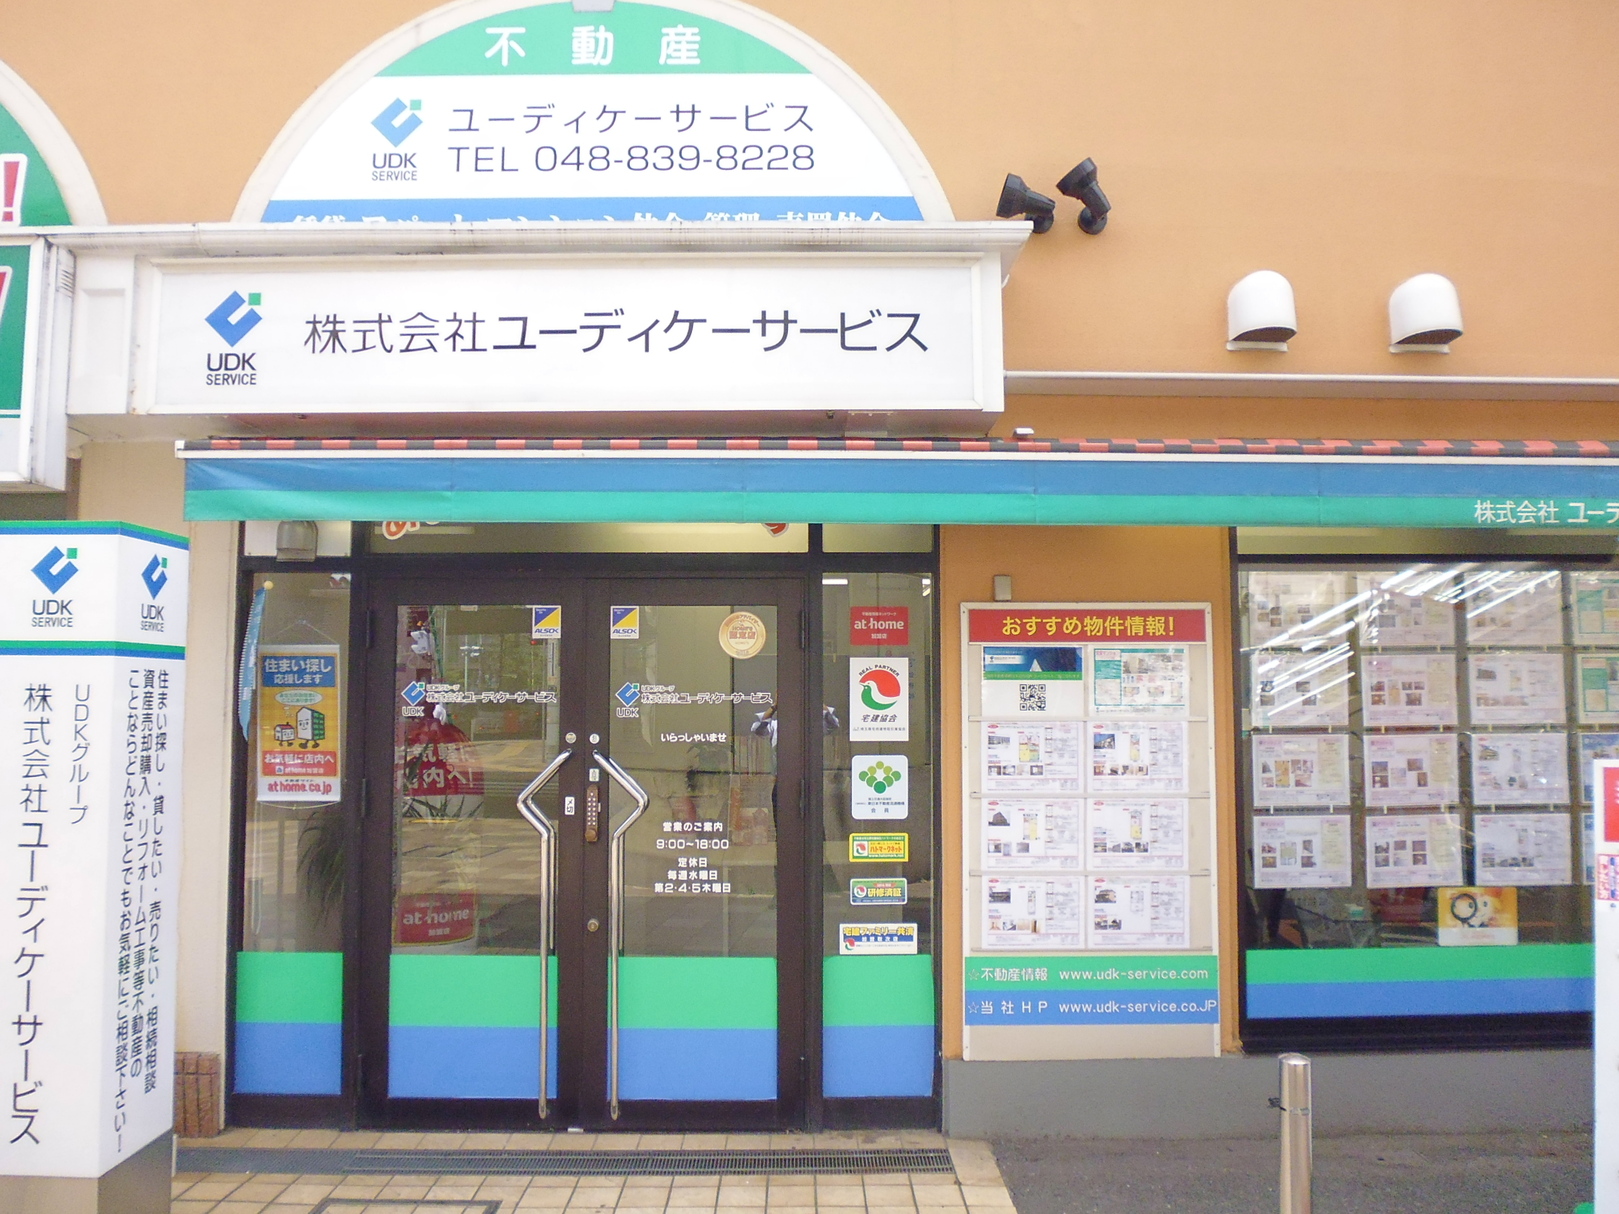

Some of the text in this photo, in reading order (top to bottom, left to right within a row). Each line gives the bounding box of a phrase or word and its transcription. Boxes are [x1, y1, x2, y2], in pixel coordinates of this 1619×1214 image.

[482, 22, 703, 68] 不動産
[448, 103, 815, 134] ユーディケーサービス
[370, 150, 418, 171] UDK
[446, 142, 817, 174] TEL 048-839-8228
[370, 170, 419, 182] SERVICE
[304, 308, 928, 354] 株式会社ユーディケーサービス
[205, 351, 258, 373] UDK
[204, 371, 258, 386] SERVICE
[1474, 499, 1561, 525] 株式会社
[32, 599, 73, 616] UDK
[140, 603, 165, 621] UDK
[31, 616, 74, 628] SERVICE
[140, 620, 165, 632] SERVICE
[854, 617, 905, 630] at home
[264, 658, 333, 673] 住まい探し
[859, 664, 900, 677] REAL PARTNER
[273, 673, 323, 685] 応援します
[425, 691, 557, 704] 株式会社ユーディケーサービス
[640, 692, 773, 704] 株式会社ユーディケーサービス
[401, 705, 426, 718] UDK
[616, 707, 640, 718] UDK
[660, 732, 727, 743] いらっしゃいませ
[68, 683, 92, 826] UDKグループ
[264, 753, 335, 765] お気軽に店内へ
[662, 821, 723, 832] 営業のご案内
[677, 857, 708, 868] 定休日
[667, 870, 718, 881] 毎週水曜日
[9, 682, 55, 1146] 株式会社ユーディケーサービス
[980, 967, 1210, 982] 不動産情報 www.udk-service.com
[1058, 1000, 1217, 1013] www.udk-service.co.JP
